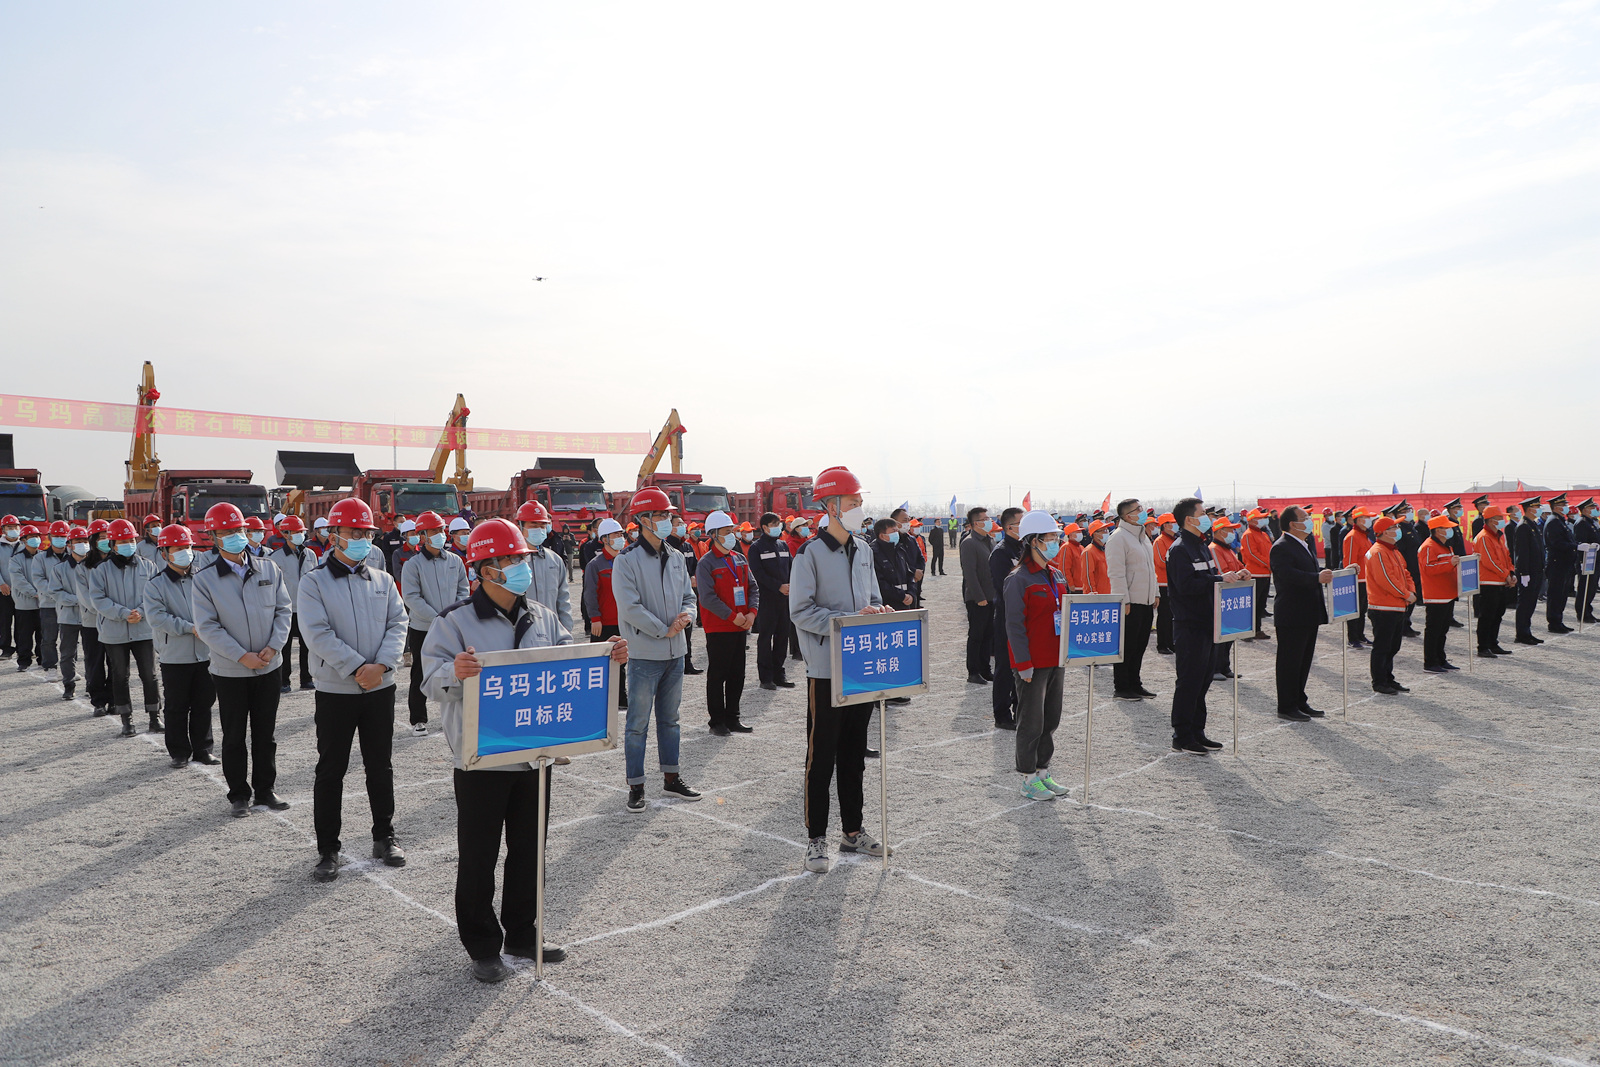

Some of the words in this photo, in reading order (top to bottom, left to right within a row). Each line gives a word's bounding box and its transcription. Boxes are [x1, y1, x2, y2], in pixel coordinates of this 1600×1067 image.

[0, 397, 644, 452] 乌玛高速公路石嘴山段暨全区交通建设重点项目集中开复工！
[1221, 595, 1252, 612] 中交公规院
[1070, 609, 1119, 626] 乌玛北项目
[842, 629, 918, 654] 乌玛北项目
[1075, 631, 1112, 645] 中心实验室
[863, 656, 900, 676] 三标段
[482, 666, 604, 700] 乌玛北项目
[515, 702, 573, 728] 四标段
